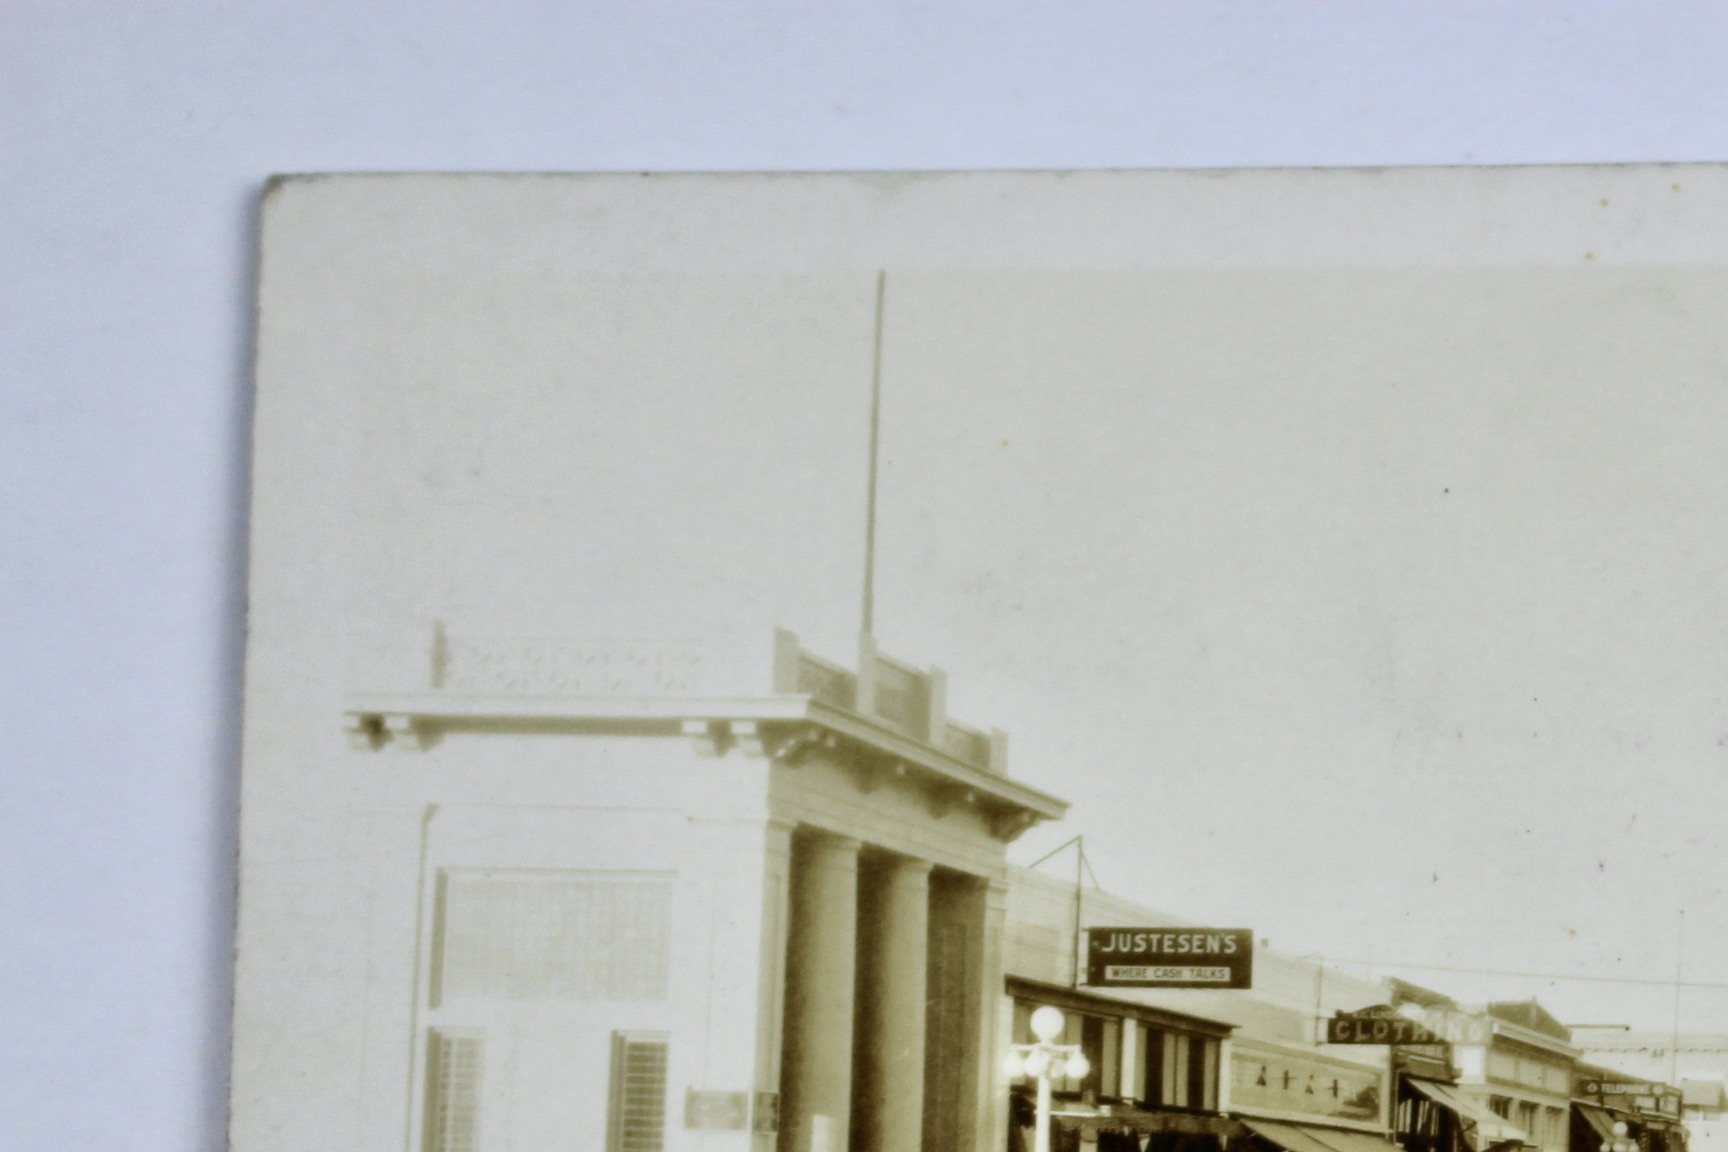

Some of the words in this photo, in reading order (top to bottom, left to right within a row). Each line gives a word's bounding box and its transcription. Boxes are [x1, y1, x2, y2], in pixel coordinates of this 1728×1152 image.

[1111, 967, 1148, 979] WHERE
[1154, 967, 1183, 979] CASH
[1189, 967, 1226, 980] TALKS
